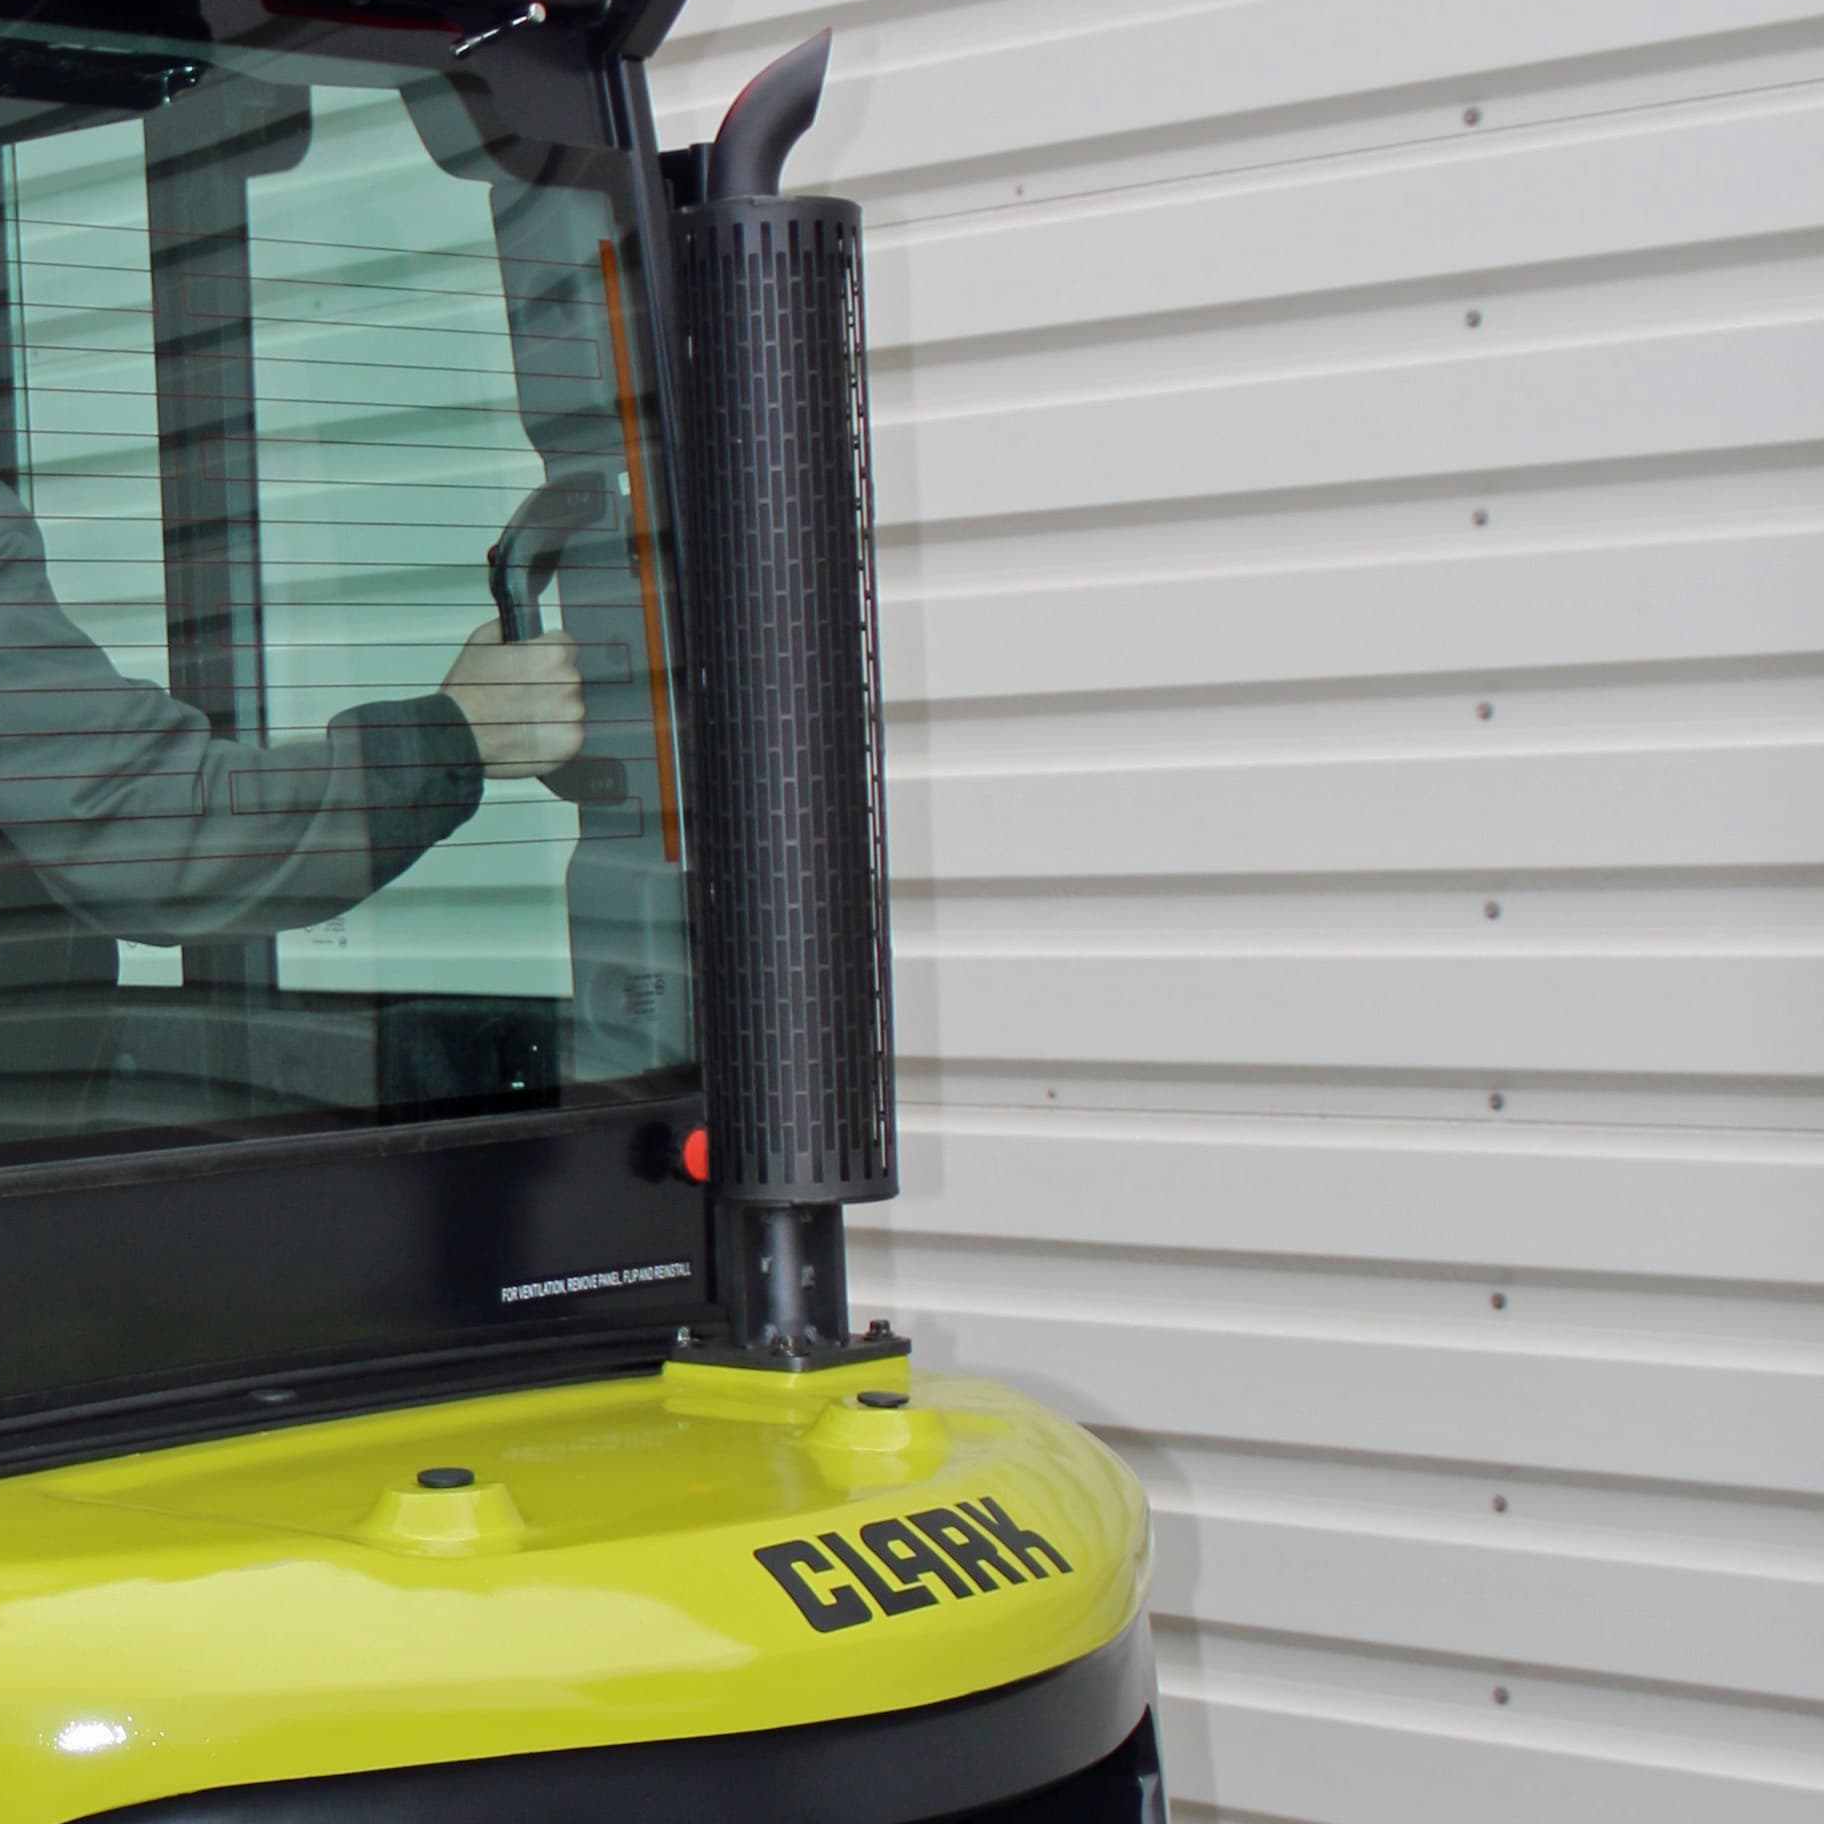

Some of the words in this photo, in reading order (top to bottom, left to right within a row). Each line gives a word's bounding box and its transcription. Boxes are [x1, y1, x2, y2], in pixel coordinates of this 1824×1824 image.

[502, 1287, 519, 1302] FOR
[567, 1274, 597, 1292] REMOVE
[623, 1268, 639, 1283] FLIP
[638, 1266, 654, 1281] AND
[654, 1262, 692, 1279] REINSTALL
[753, 1496, 1074, 1633] CLARK
